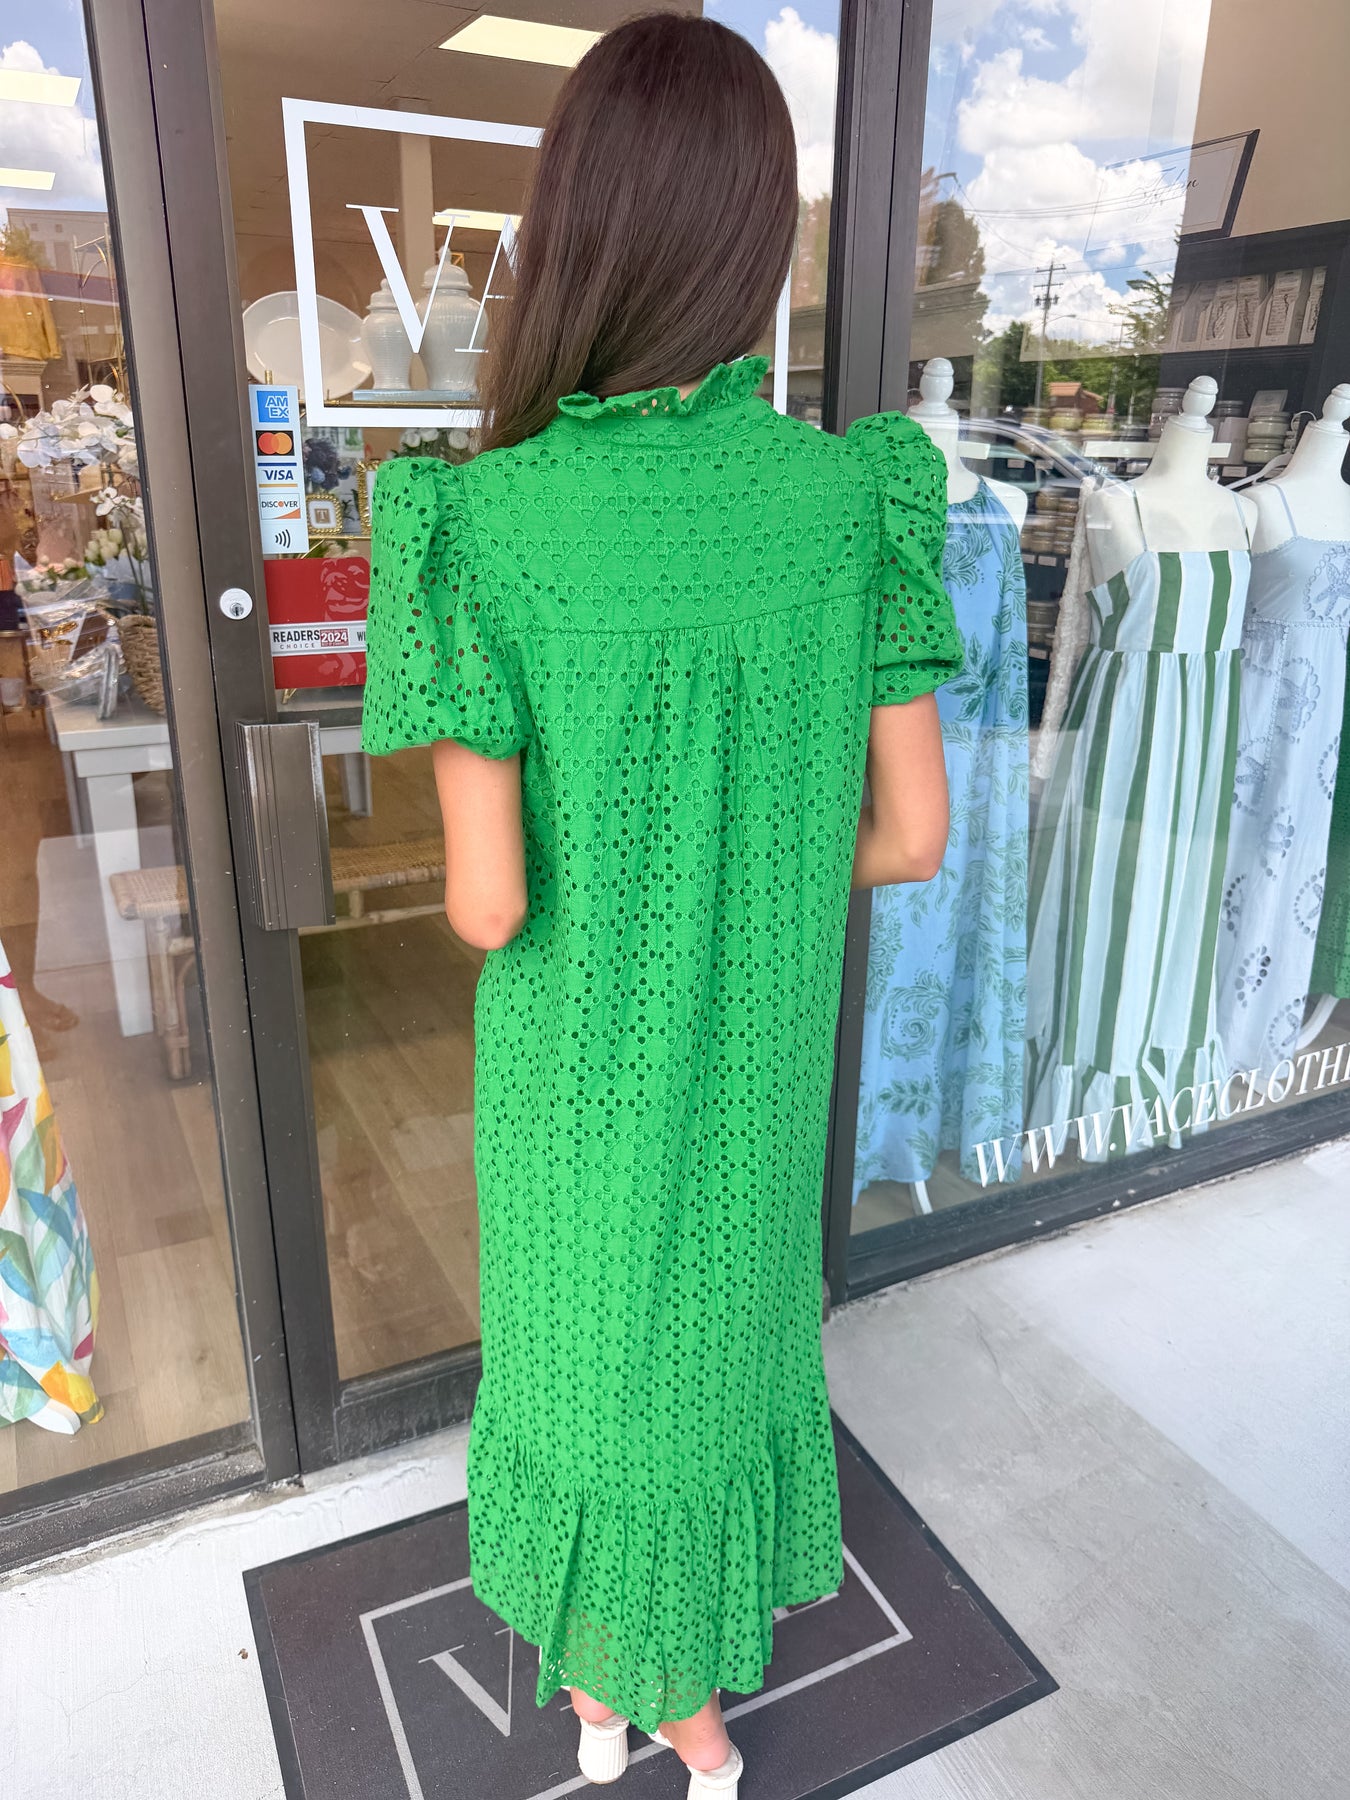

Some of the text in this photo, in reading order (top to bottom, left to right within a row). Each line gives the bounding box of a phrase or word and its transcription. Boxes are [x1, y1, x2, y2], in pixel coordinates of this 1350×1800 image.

[265, 395, 289, 407] AM
[268, 407, 289, 419] EX
[262, 469, 294, 481] VISA
[261, 500, 299, 509] DISCOVER
[272, 629, 320, 643] READERS
[320, 631, 348, 643] 2024
[279, 642, 316, 650] CHOICE
